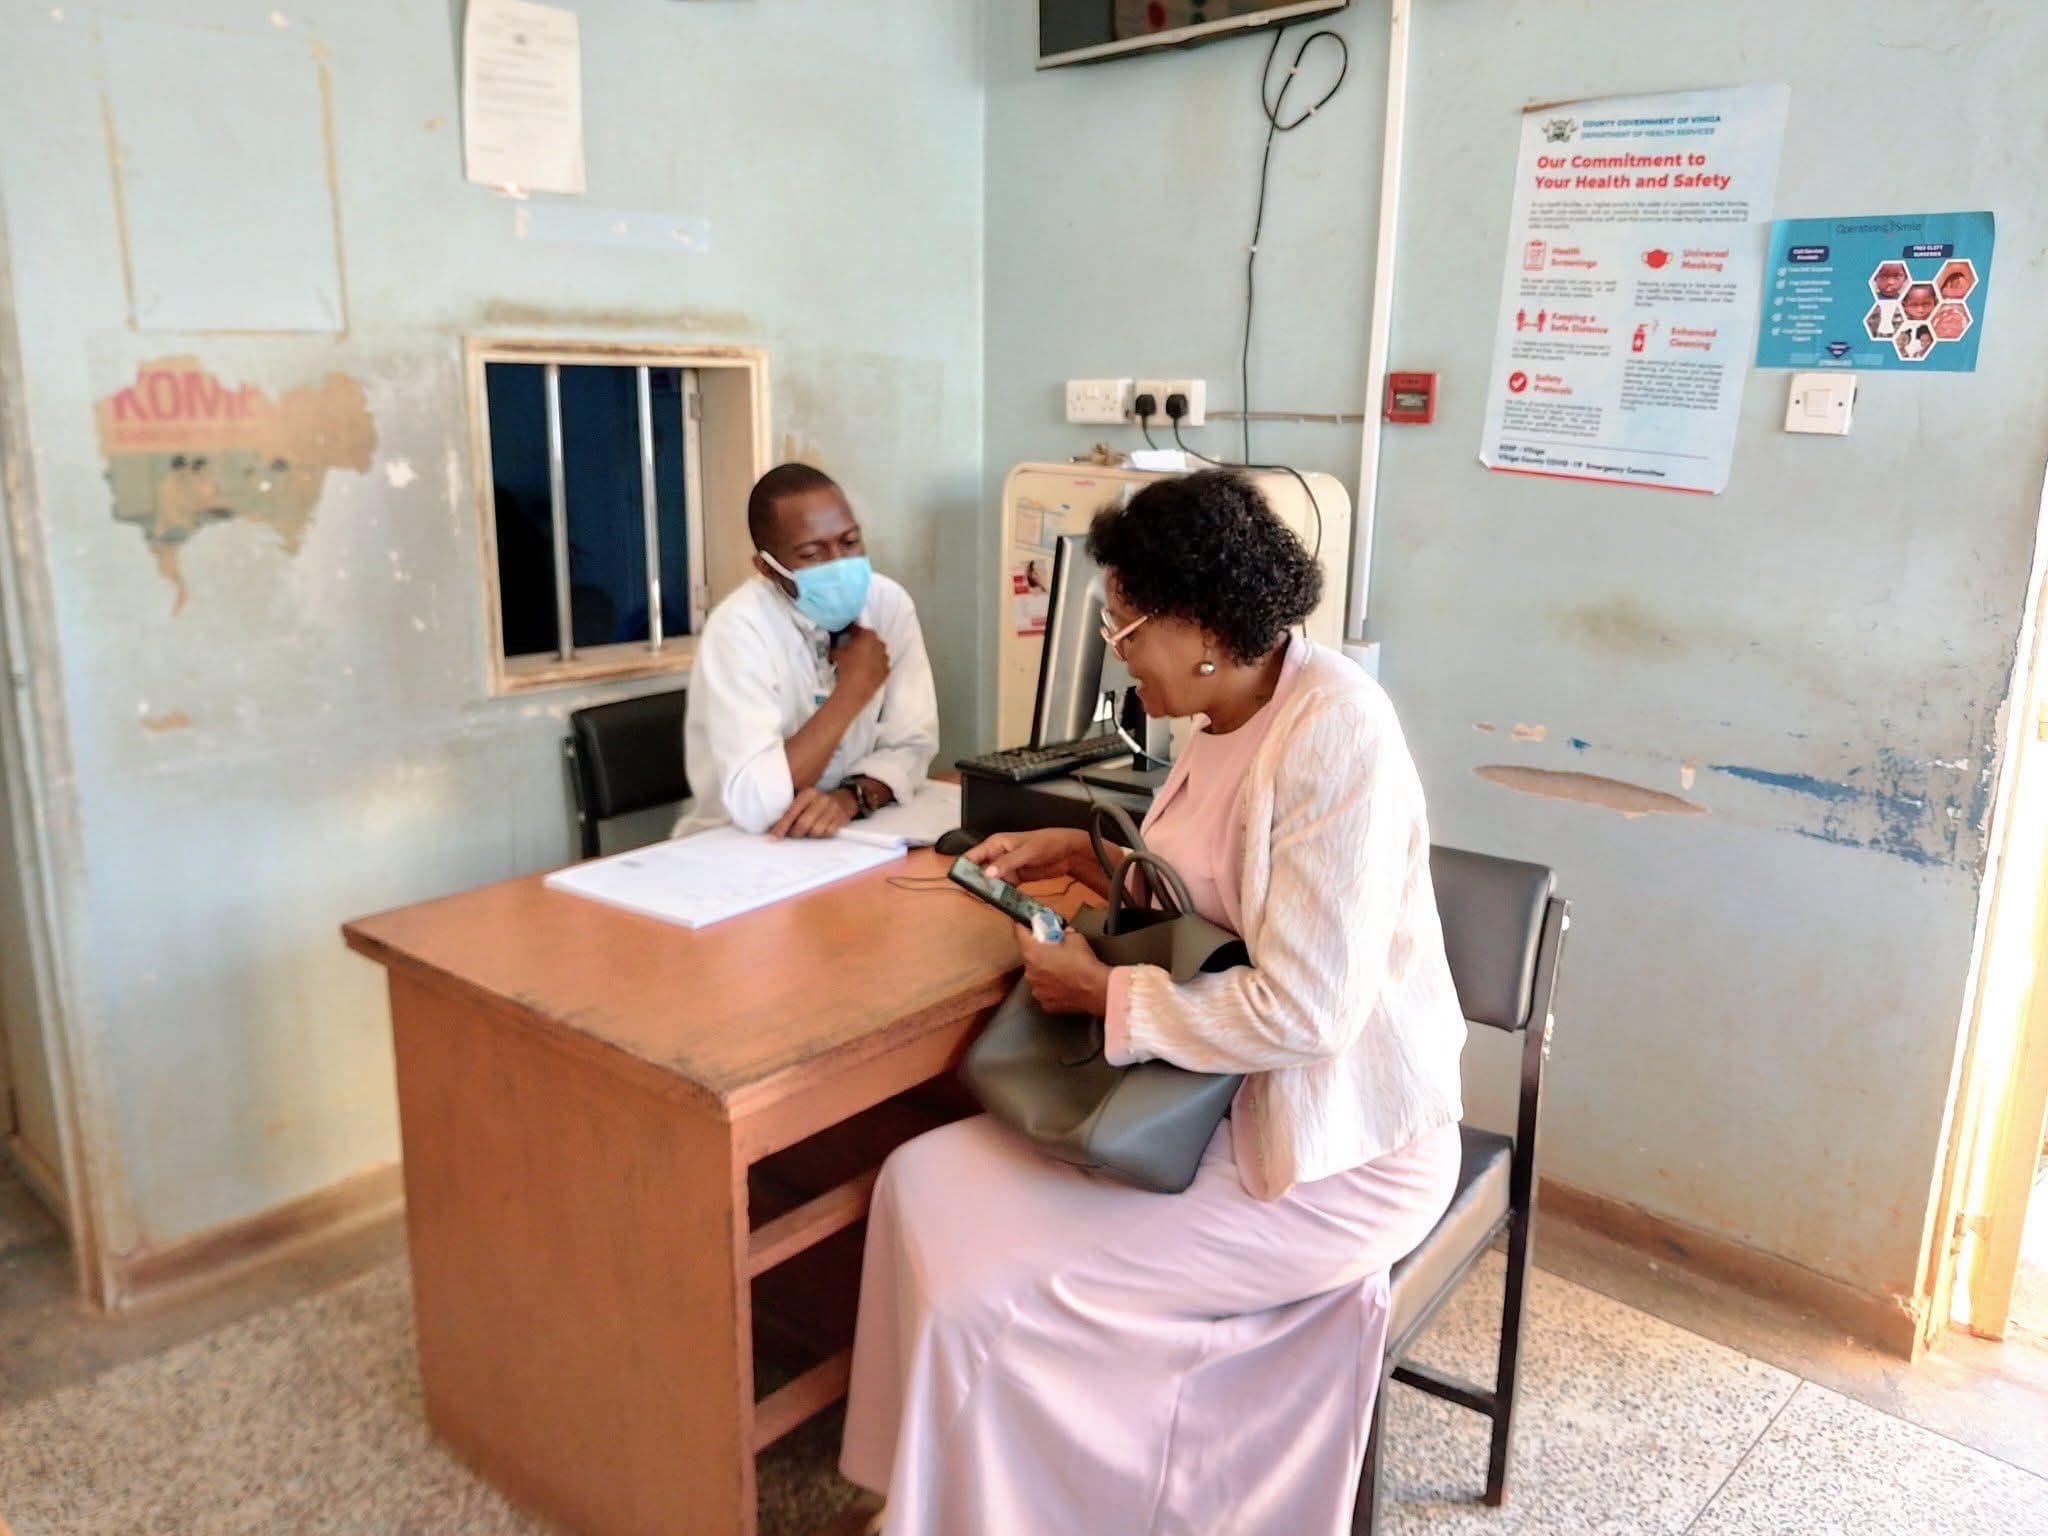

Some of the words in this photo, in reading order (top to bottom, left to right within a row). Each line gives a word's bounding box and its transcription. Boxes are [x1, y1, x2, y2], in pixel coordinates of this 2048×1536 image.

[1537, 155, 1566, 169] Our
[1571, 152, 1682, 169] Commitment
[1688, 153, 1706, 167] to
[1535, 176, 1570, 190] Your
[1575, 174, 1631, 189] Health
[1635, 173, 1668, 188] and
[1673, 172, 1731, 190] Safety
[1683, 248, 1729, 258] Universal
[1681, 260, 1723, 272] Masking
[1671, 327, 1717, 338] Enhanced
[1670, 338, 1712, 351] Cleaning
